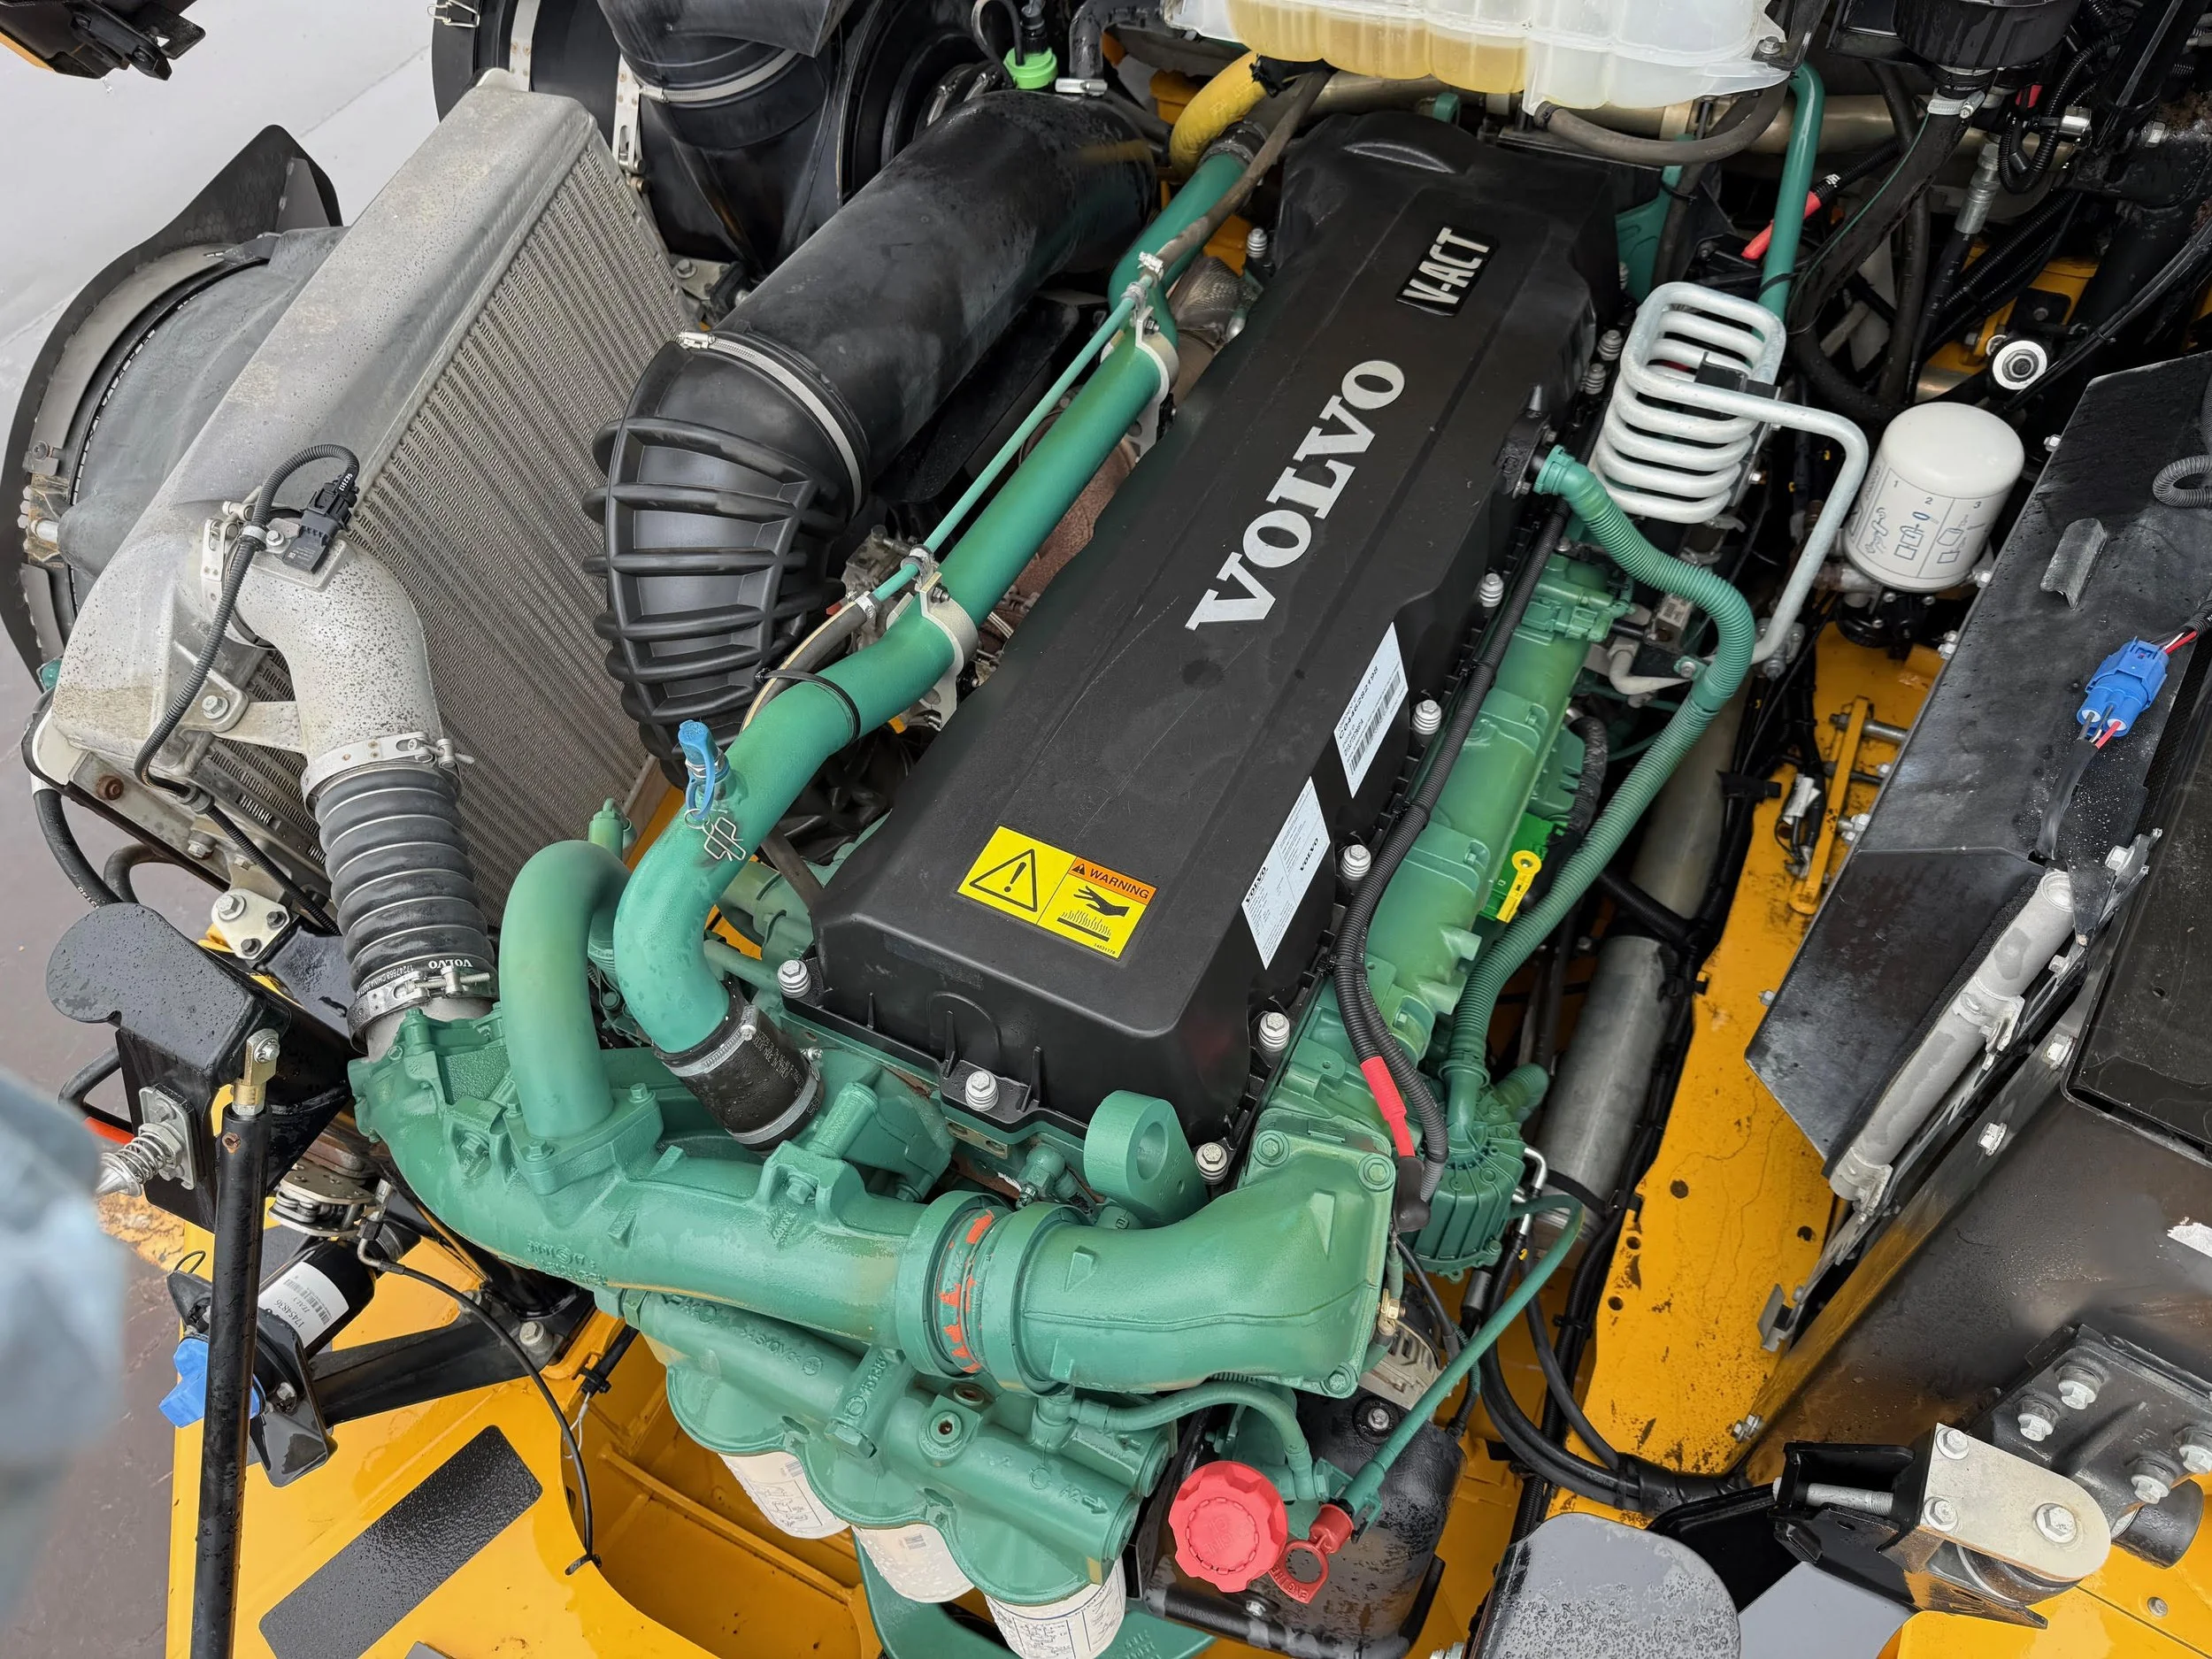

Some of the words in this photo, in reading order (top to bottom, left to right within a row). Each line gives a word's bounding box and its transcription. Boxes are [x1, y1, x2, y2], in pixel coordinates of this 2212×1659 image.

[1402, 227, 1489, 303] V-ACT
[1185, 360, 1405, 631] VOLVO
[1924, 496, 1933, 505] 2
[1300, 838, 1318, 872] VOLVO
[1090, 868, 1149, 899] WARNING
[1246, 866, 1266, 902] VOLVO
[428, 958, 473, 970] VOLVO
[274, 1299, 304, 1327] 17454836
